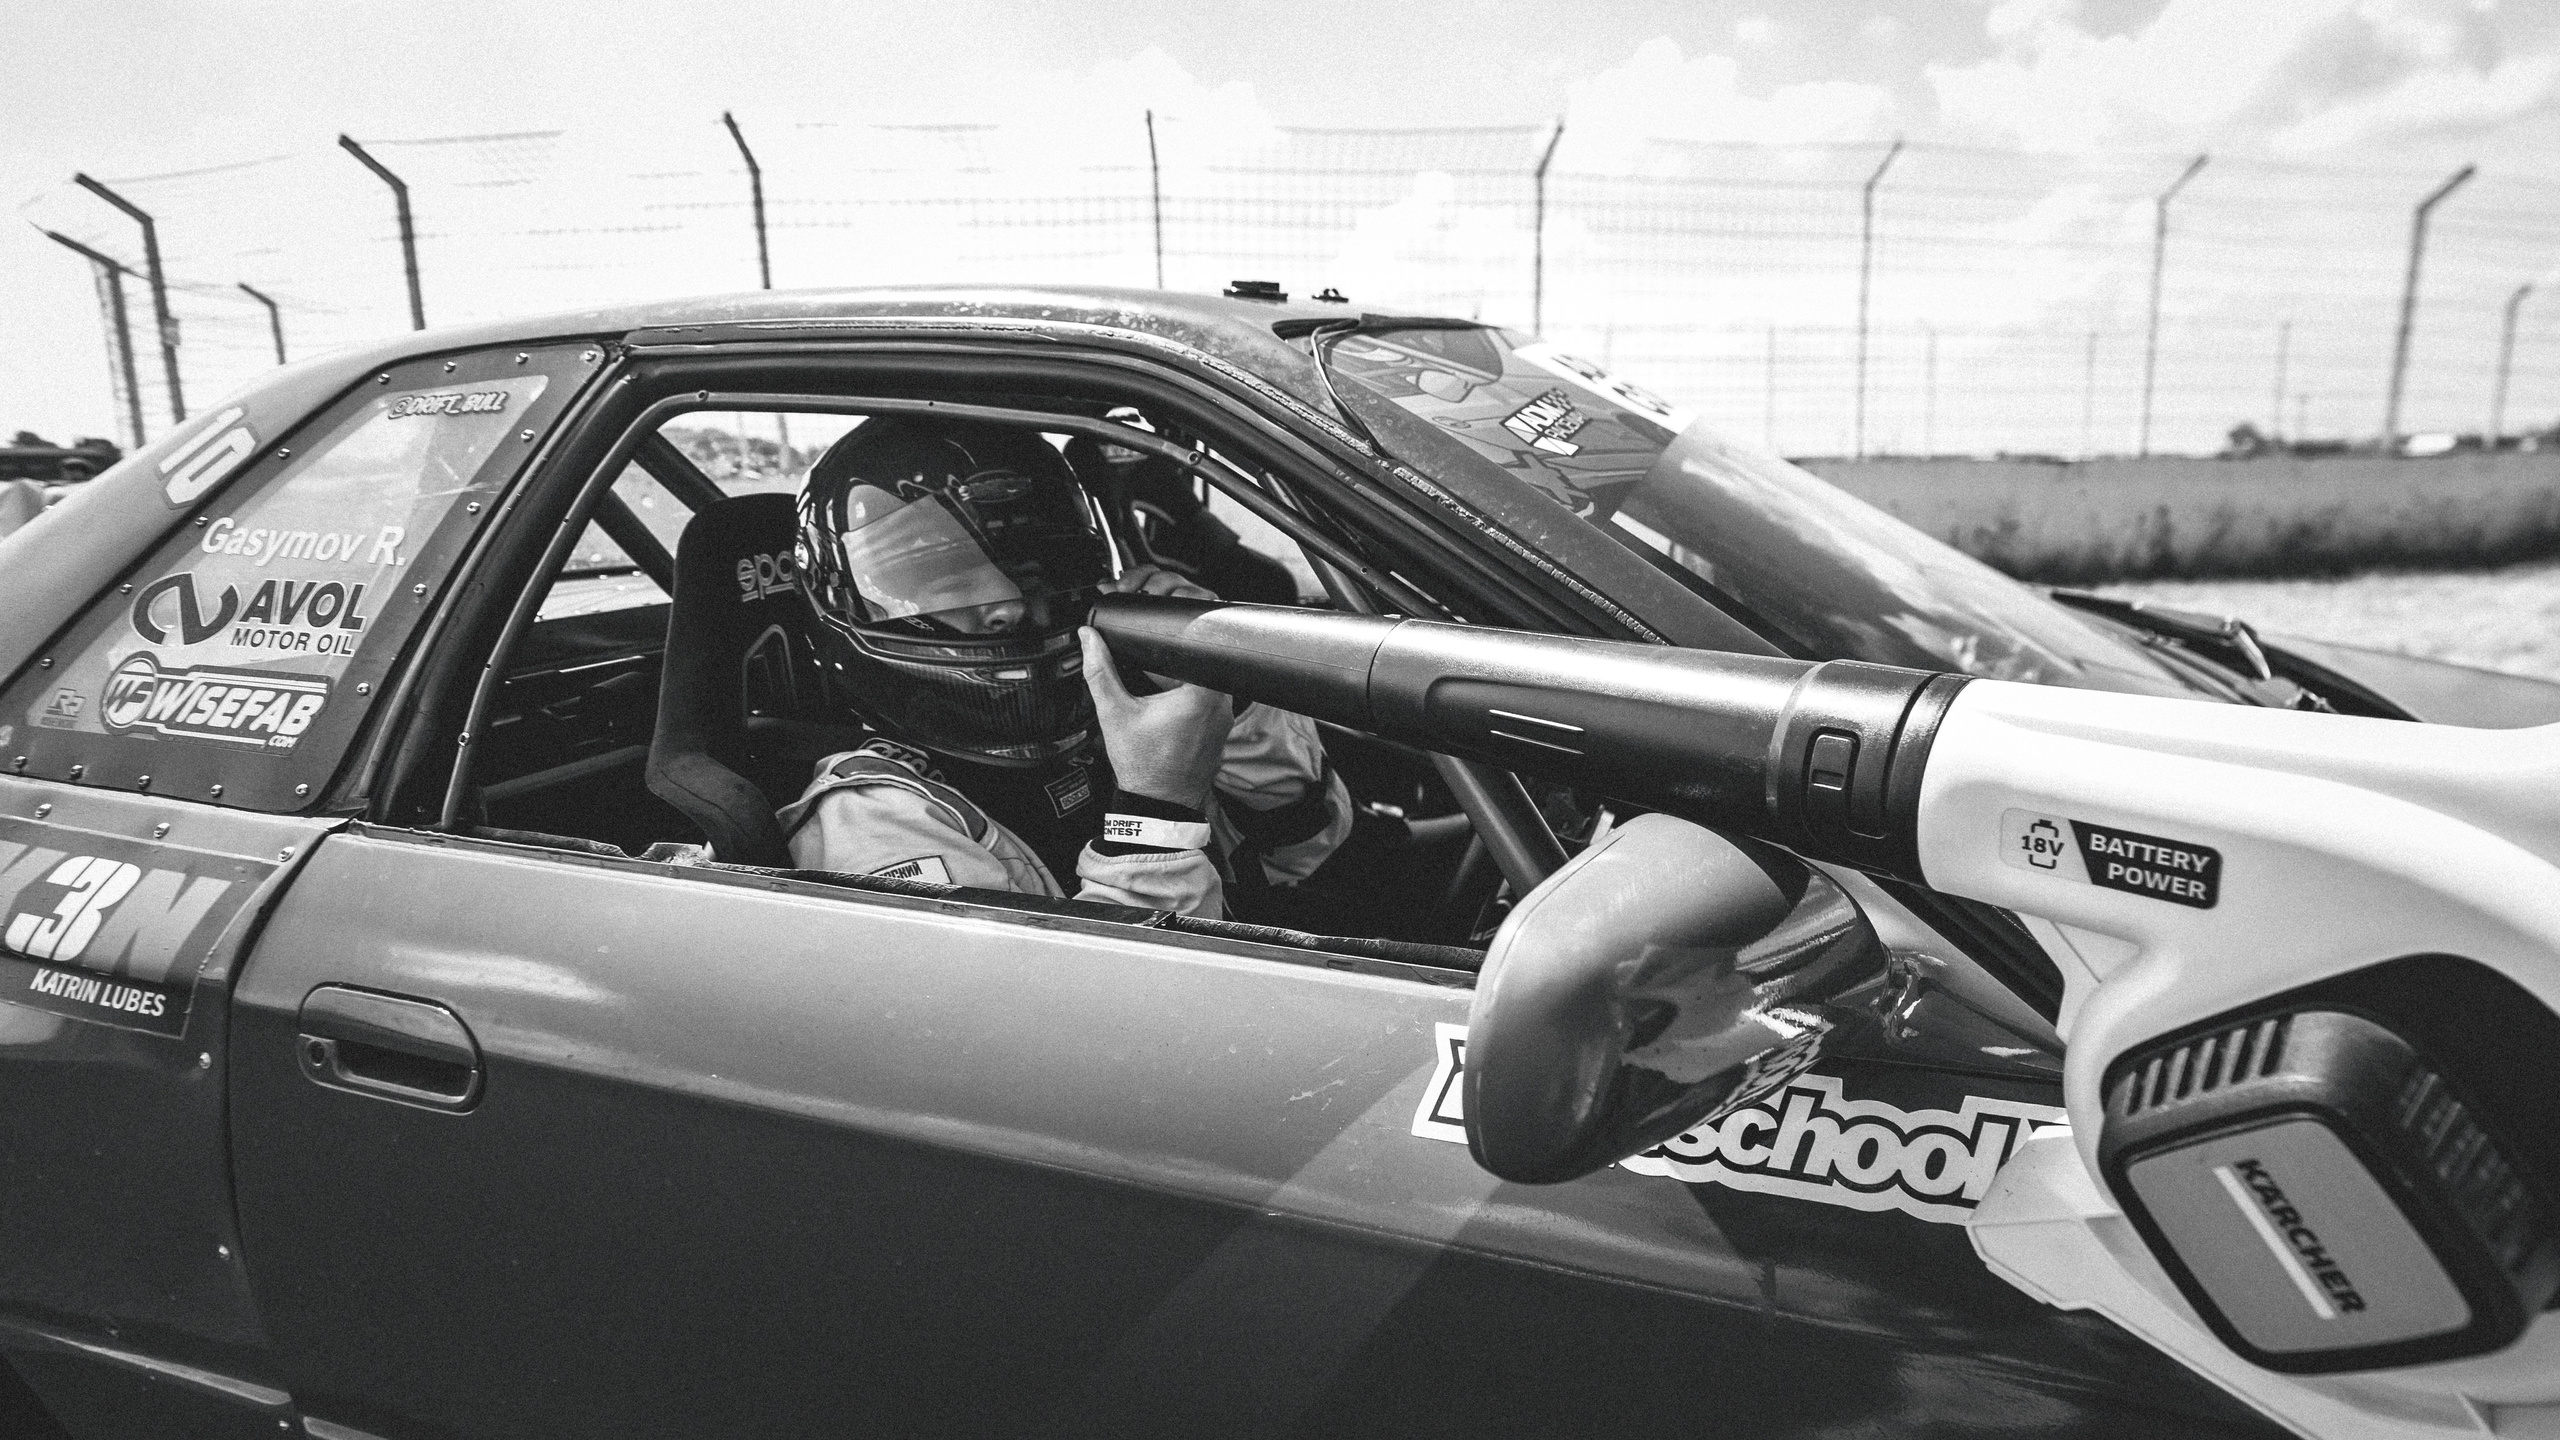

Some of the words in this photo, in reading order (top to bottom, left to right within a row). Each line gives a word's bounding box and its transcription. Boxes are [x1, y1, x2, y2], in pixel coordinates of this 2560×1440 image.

[201, 517, 366, 567] Gasymov
[366, 525, 406, 566] R.
[237, 578, 368, 632] AVOL
[230, 627, 310, 651] MOTOR
[316, 633, 356, 657] OIL
[145, 680, 325, 735] WISEFAB
[1112, 820, 1143, 828] DRIFT
[2021, 835, 2065, 857] 18V
[2089, 832, 2211, 874] BATTERY
[2107, 862, 2207, 900] POWER
[29, 968, 101, 1004] KATRIN
[100, 983, 167, 1017] LUBES
